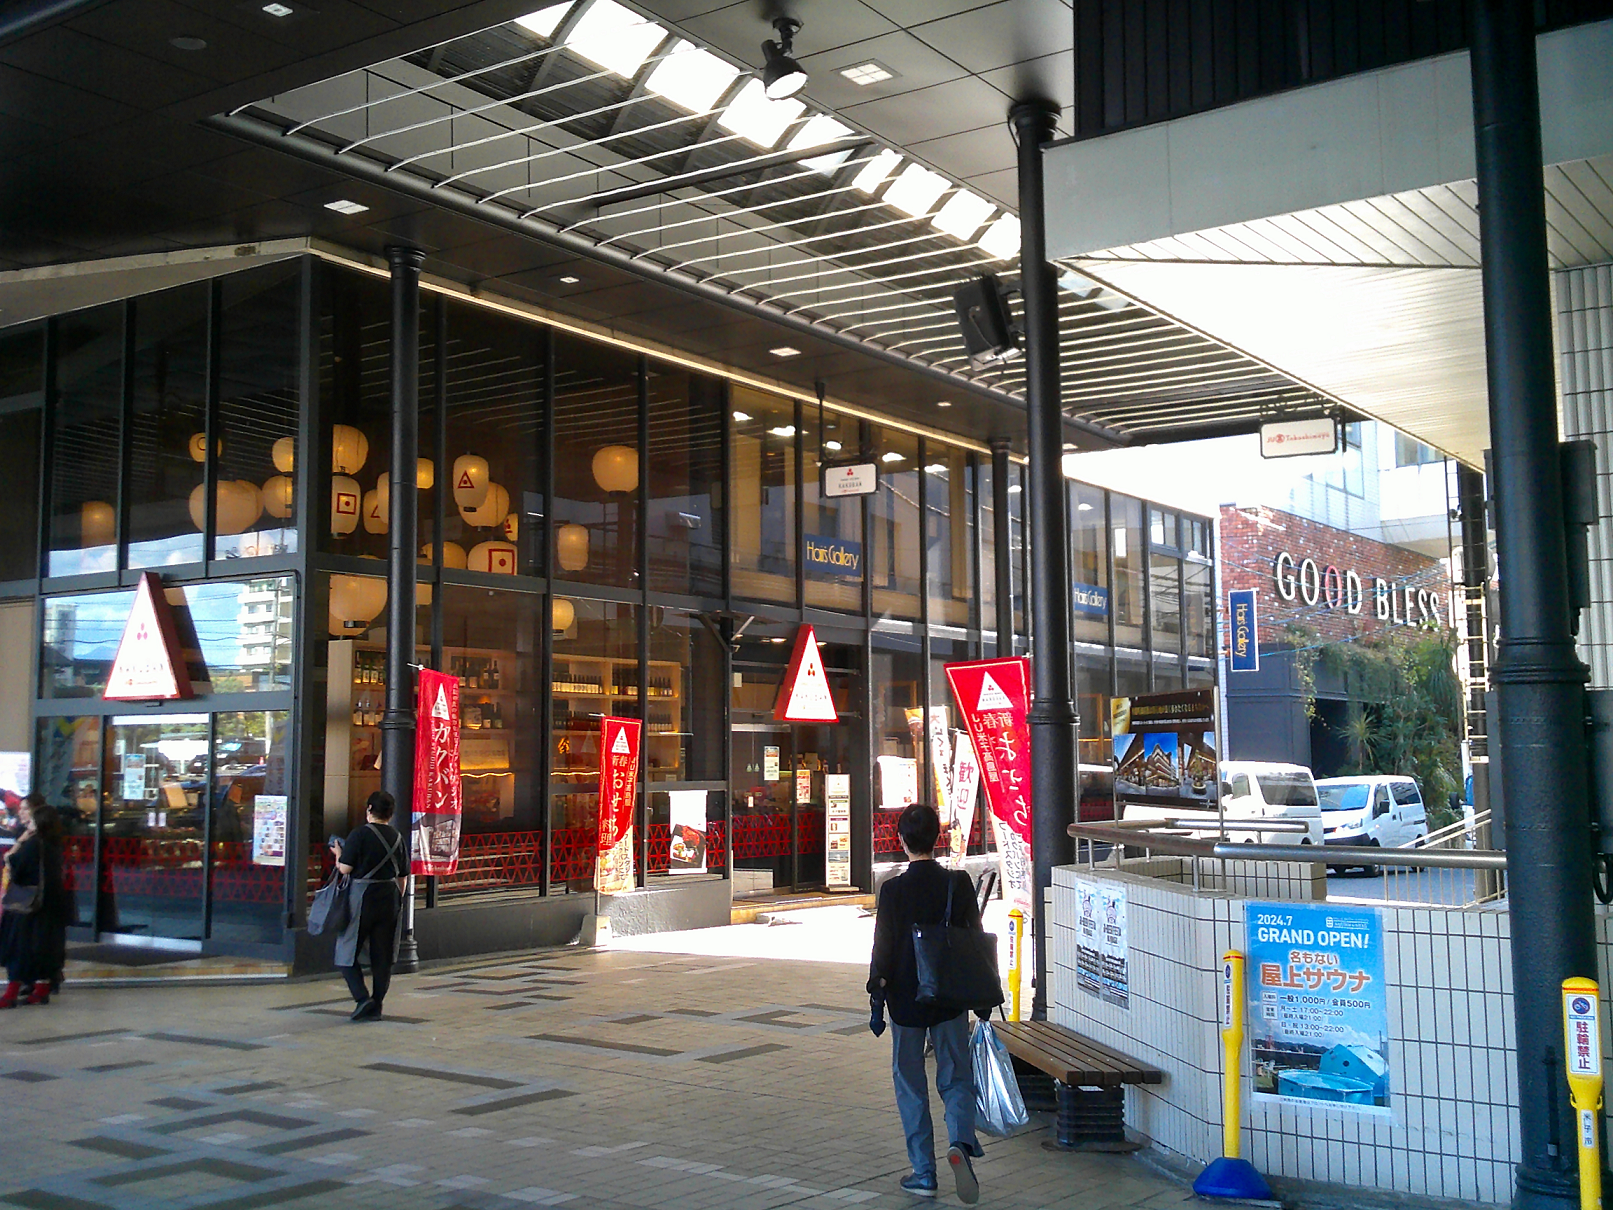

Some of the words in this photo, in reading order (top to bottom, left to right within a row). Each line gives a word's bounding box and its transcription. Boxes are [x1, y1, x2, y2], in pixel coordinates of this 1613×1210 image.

[1286, 432, 1330, 442] Takashimaya
[1275, 551, 1363, 615] GOOD
[1376, 578, 1441, 632] BLESS
[434, 722, 451, 809] カクバン
[612, 755, 628, 767] 新春
[426, 772, 434, 809] KAKUBAN
[1257, 914, 1293, 926] 2024.7
[1257, 927, 1315, 945] GRAND
[1317, 931, 1370, 949] OPEN!
[1290, 951, 1339, 965] 名もない
[1261, 964, 1371, 993] 屋上サウナ
[1576, 1022, 1591, 1070] 駐輪禁止
